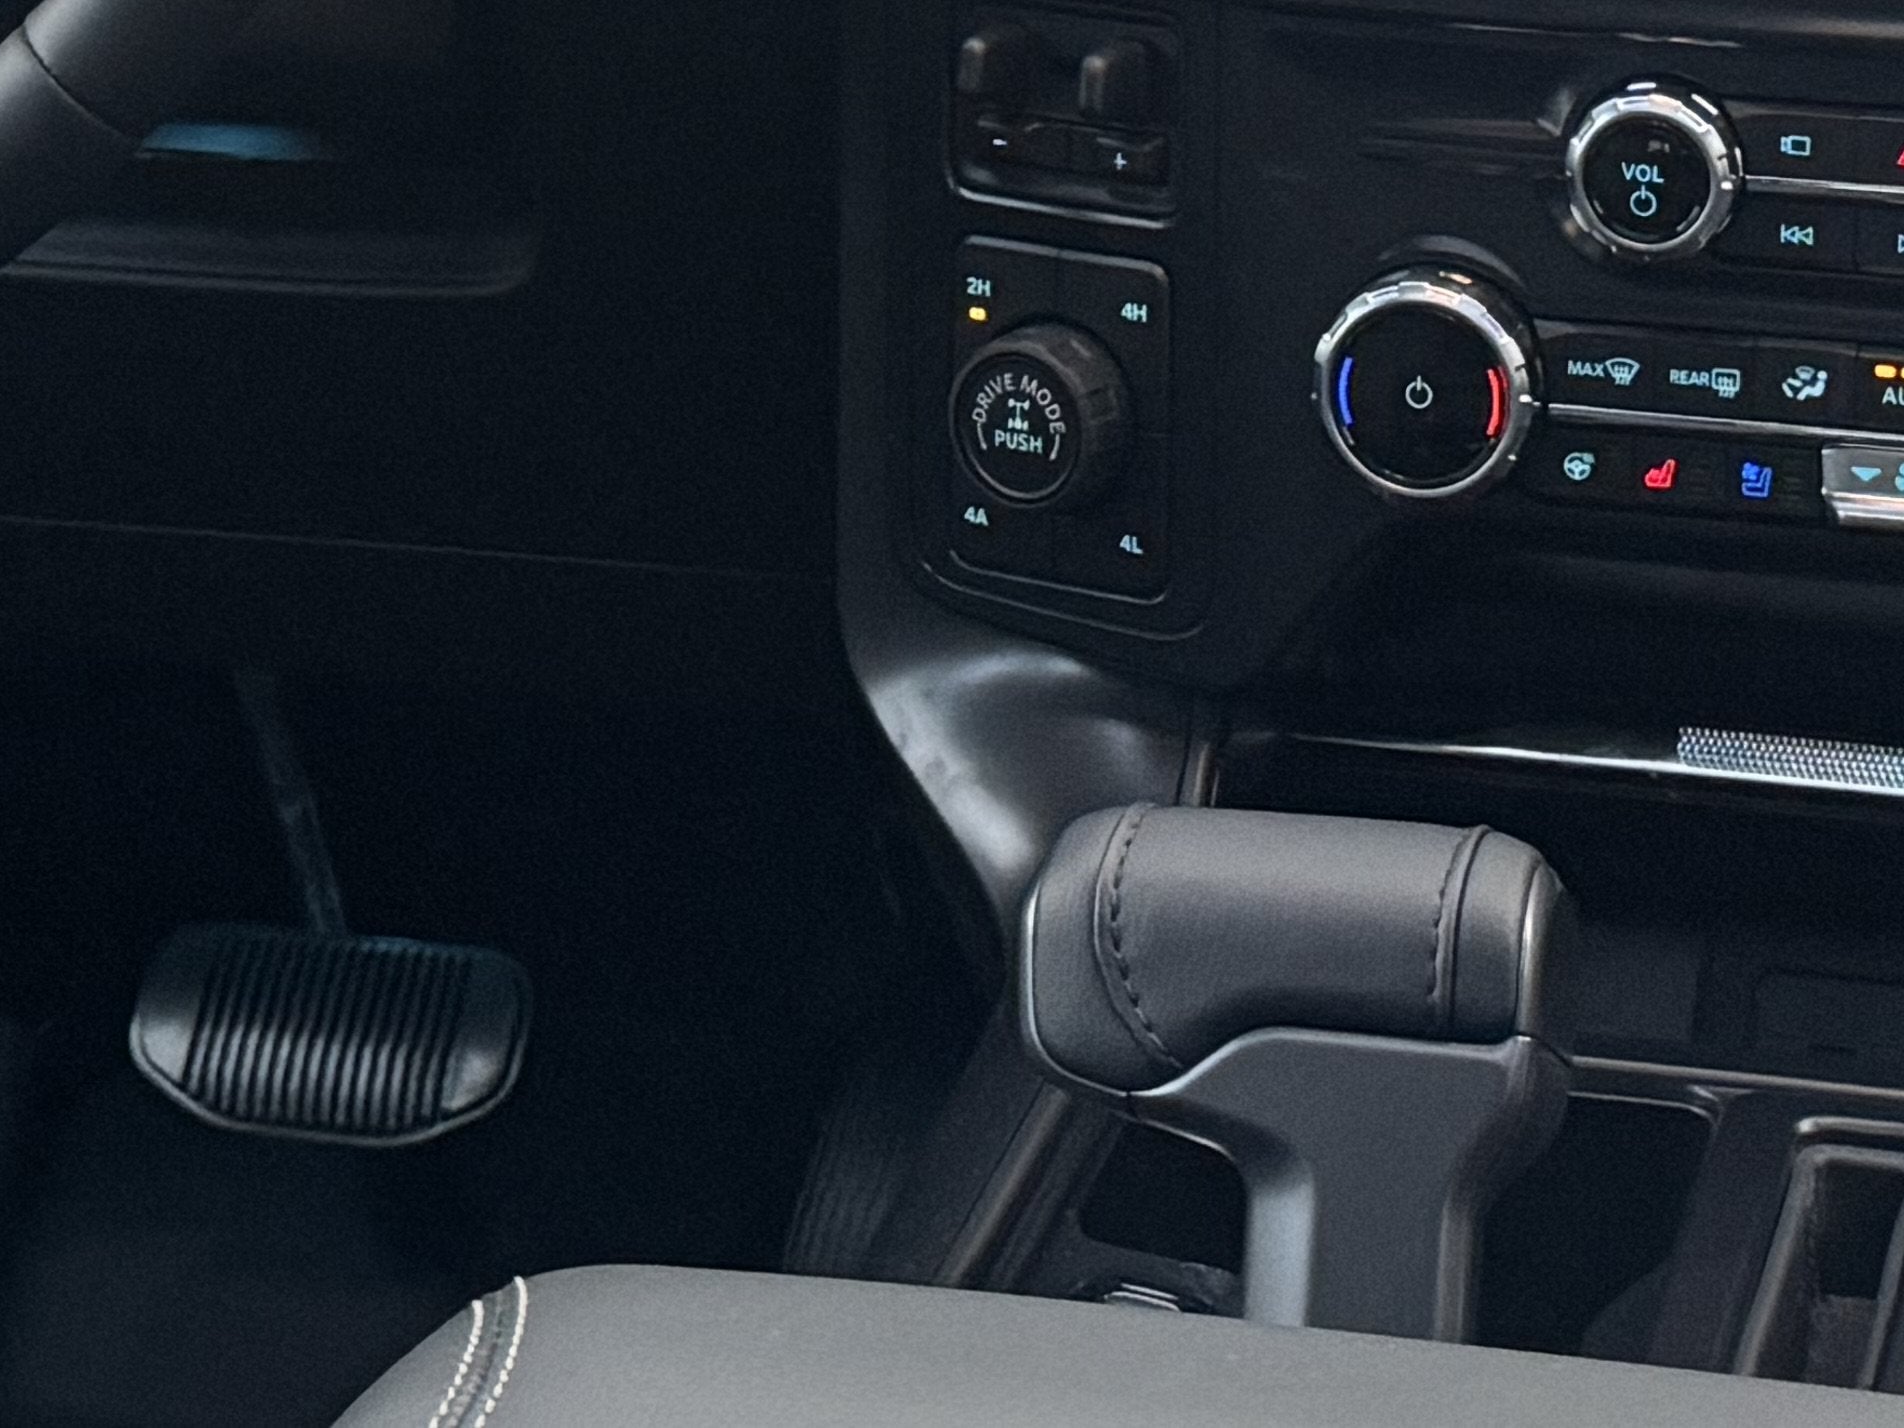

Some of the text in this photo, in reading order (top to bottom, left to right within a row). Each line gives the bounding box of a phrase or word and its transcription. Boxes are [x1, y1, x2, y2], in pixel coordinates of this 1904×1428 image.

[1621, 161, 1665, 185] VOL
[966, 276, 991, 297] 2H
[1120, 302, 1148, 323] 4H
[1567, 359, 1606, 379] MAX
[1669, 369, 1710, 387] REAR
[971, 372, 1067, 435] DRIVE MODE
[994, 428, 1044, 455] PUSH
[963, 506, 989, 527] 4A
[1119, 534, 1144, 555] 4L
